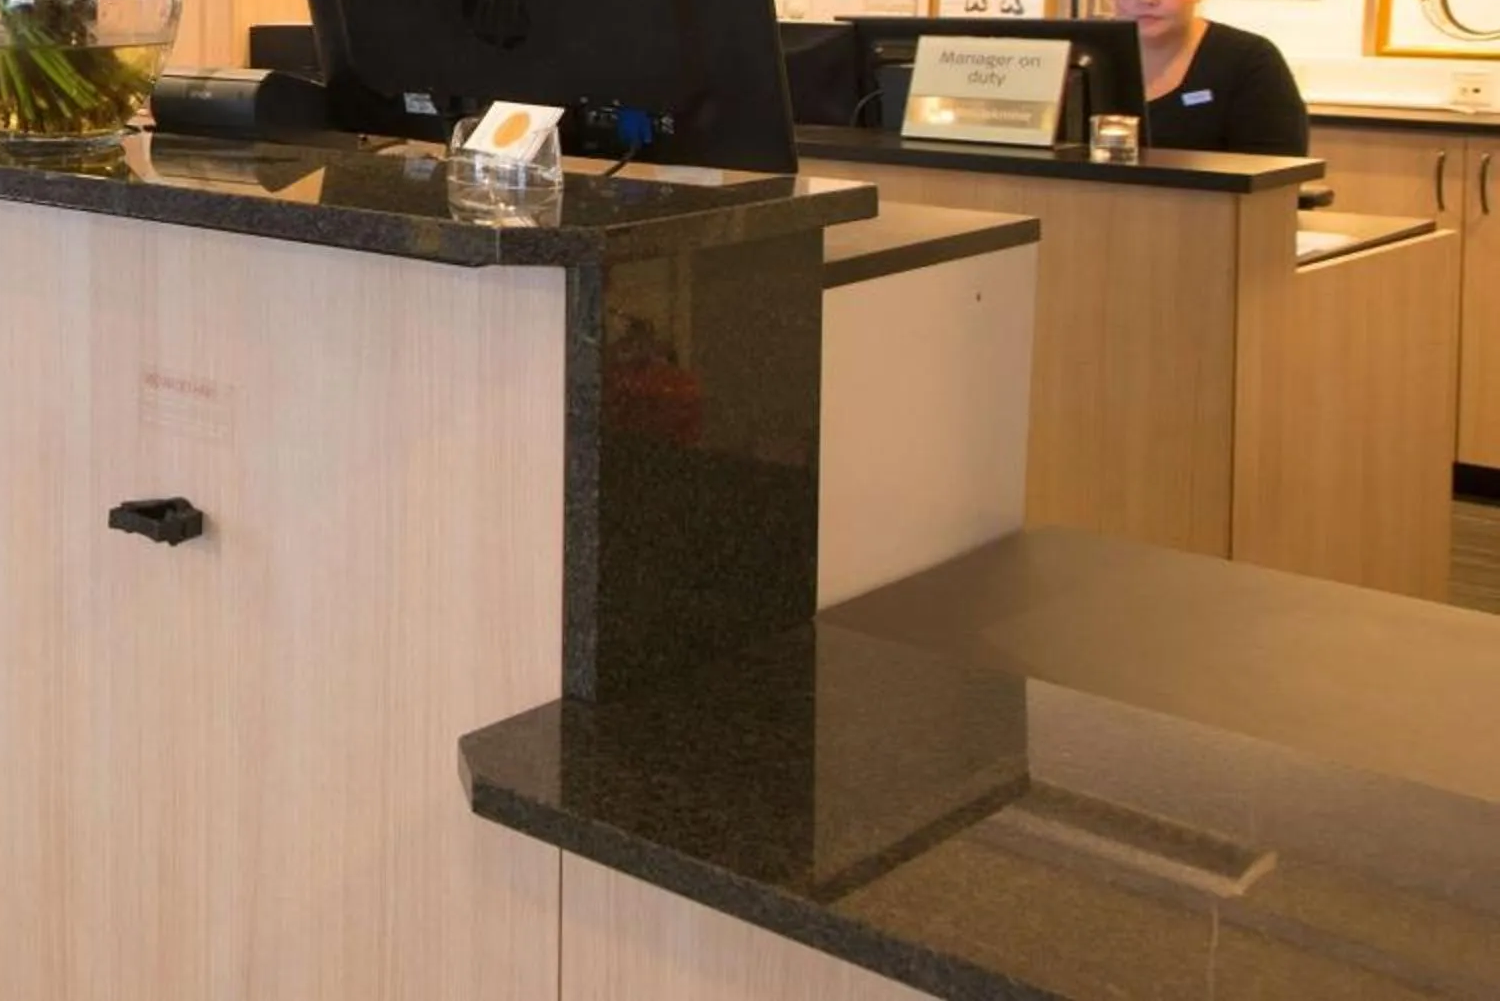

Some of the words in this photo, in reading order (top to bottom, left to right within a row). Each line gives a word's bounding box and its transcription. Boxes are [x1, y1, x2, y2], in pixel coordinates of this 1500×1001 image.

[939, 51, 1013, 68] Manager
[1019, 55, 1041, 67] on
[967, 70, 1006, 87] duty
